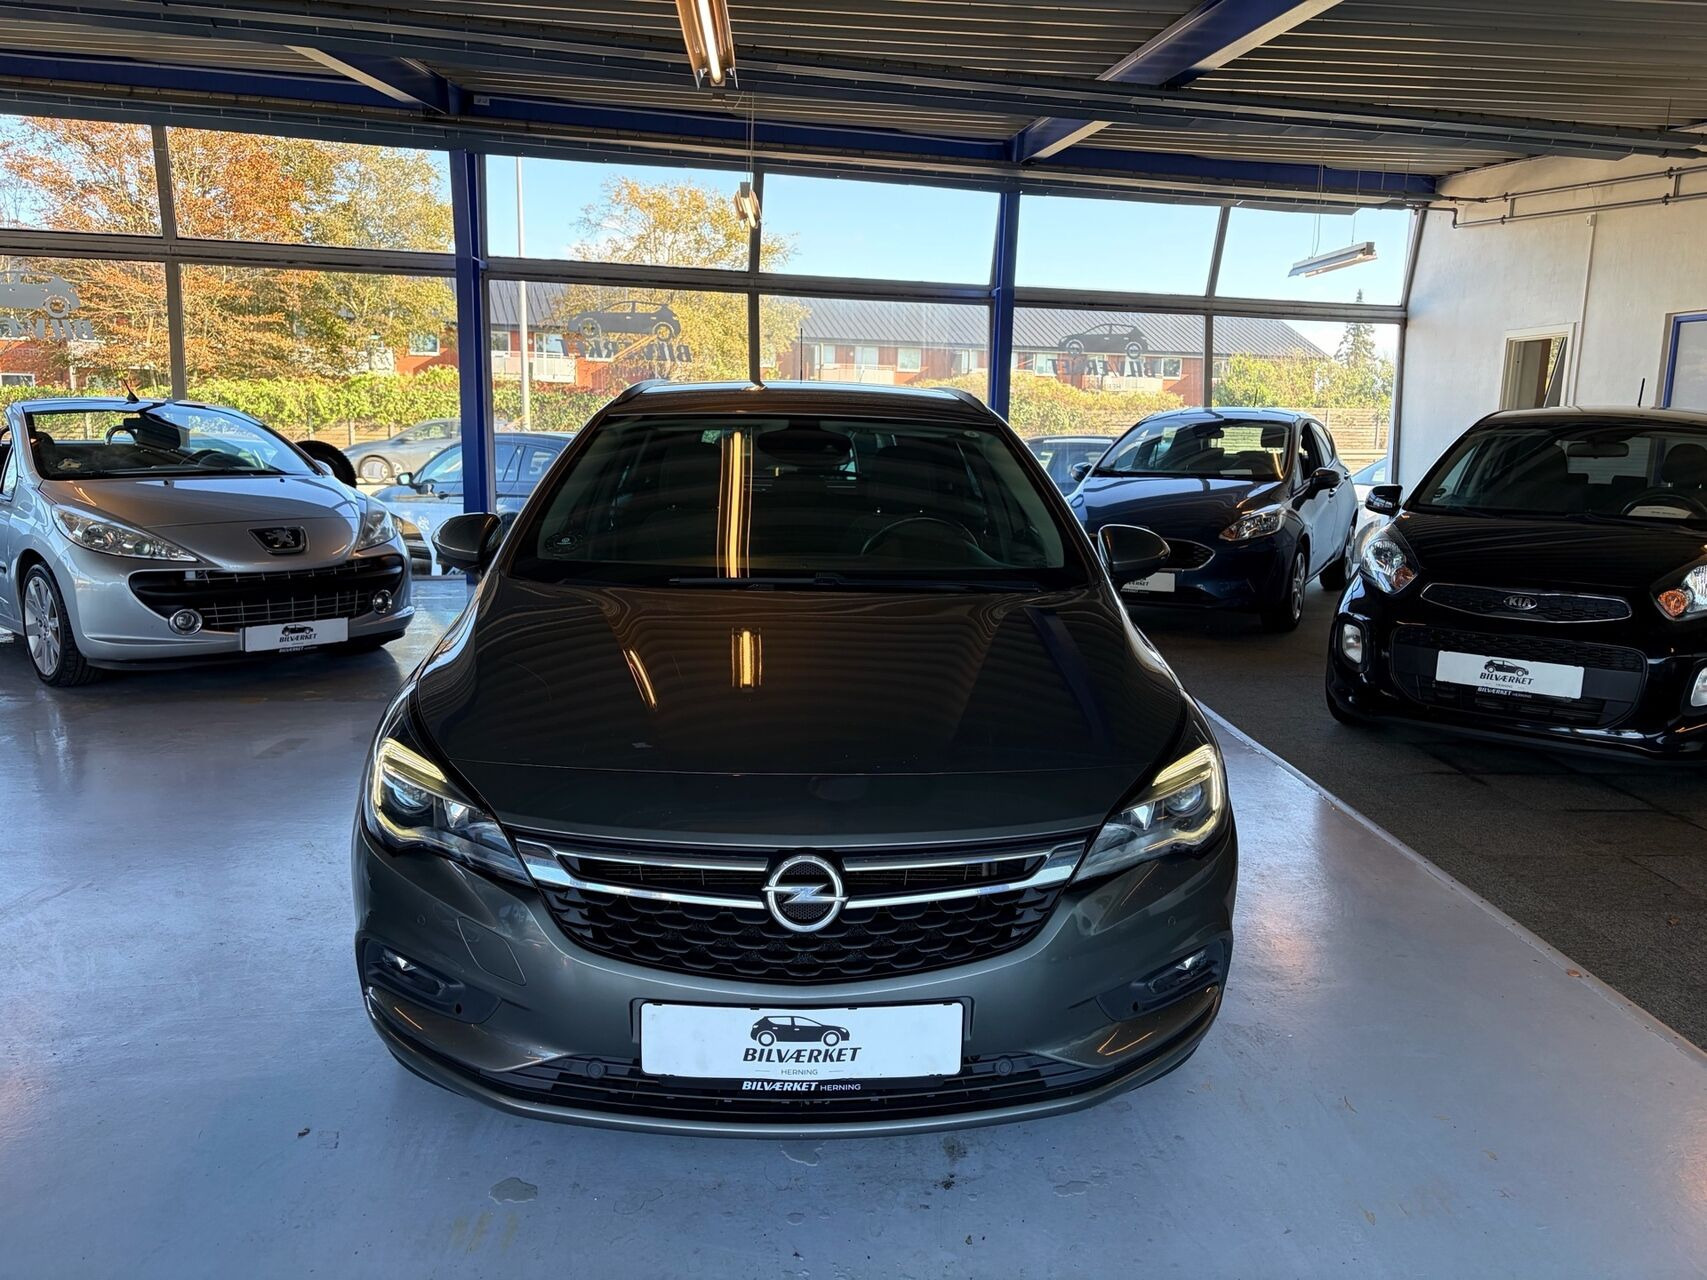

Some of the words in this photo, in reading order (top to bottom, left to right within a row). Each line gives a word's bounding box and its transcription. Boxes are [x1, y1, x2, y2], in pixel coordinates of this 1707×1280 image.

[1509, 597, 1531, 607] KIA
[1480, 672, 1534, 685] BILVÆRKET
[743, 1047, 862, 1063] BILVÆRKET
[742, 1081, 818, 1091] BILVÆRKET
